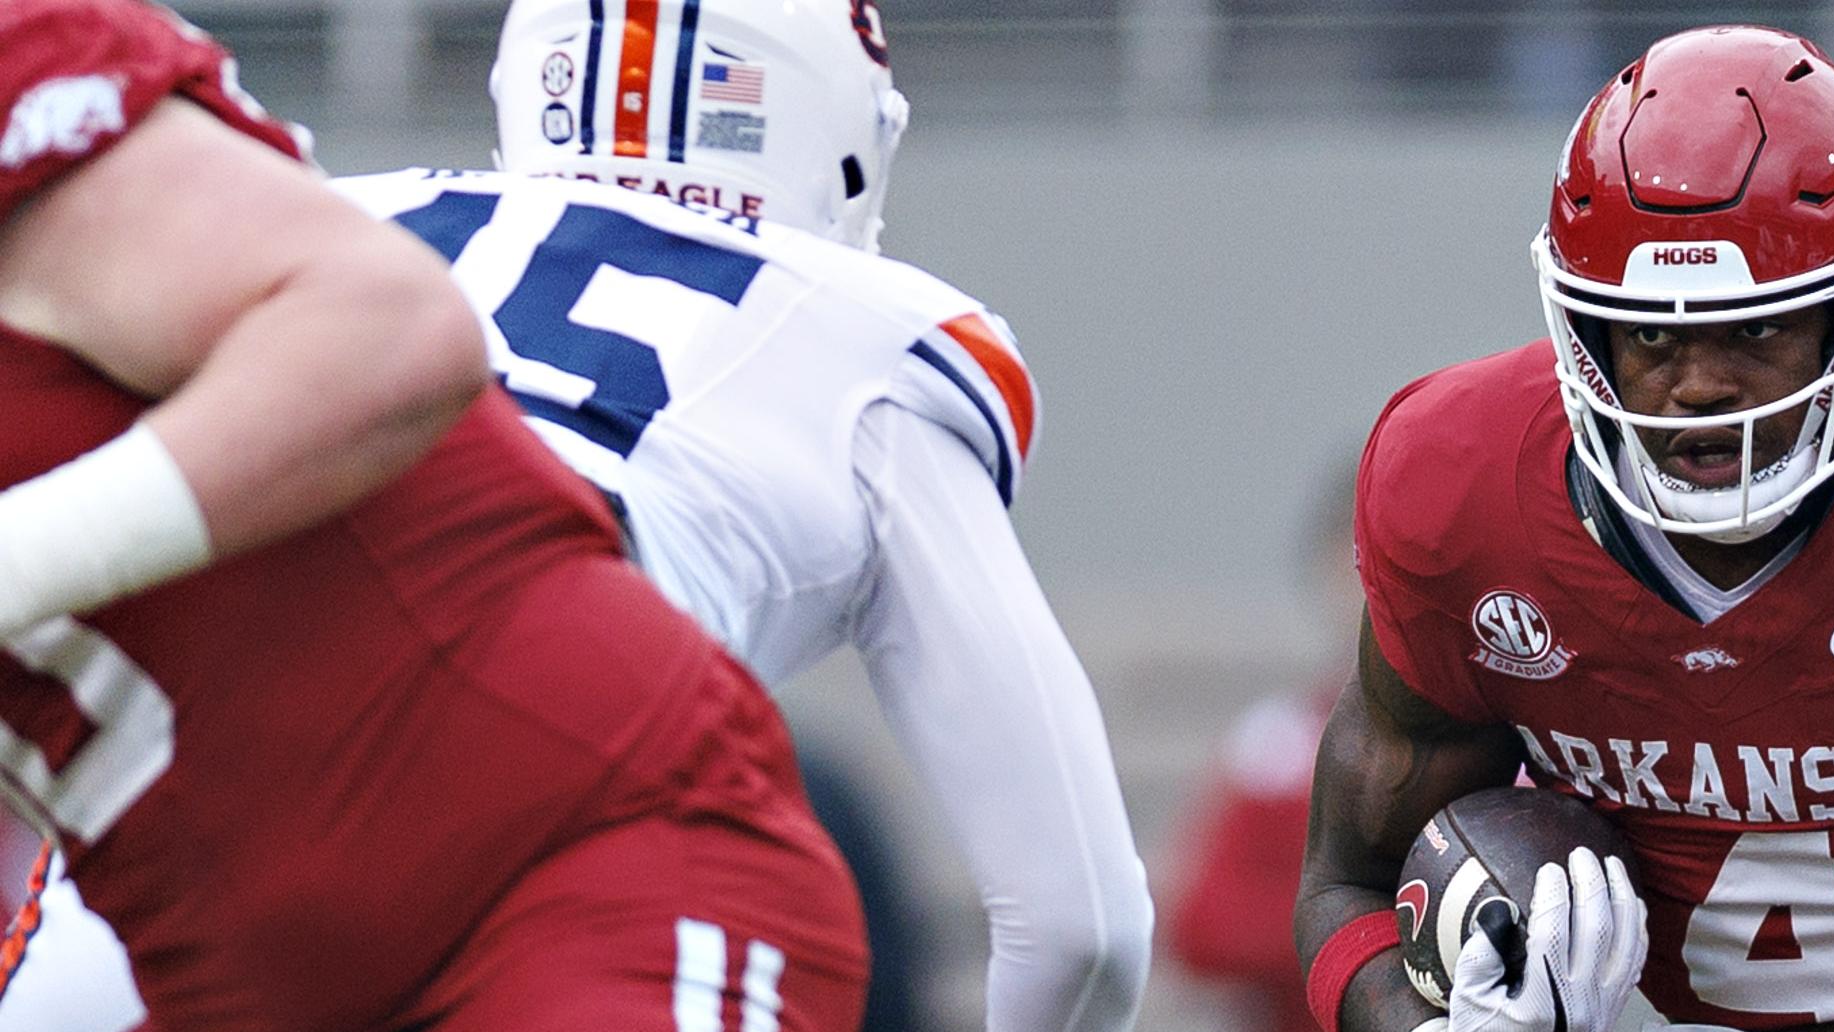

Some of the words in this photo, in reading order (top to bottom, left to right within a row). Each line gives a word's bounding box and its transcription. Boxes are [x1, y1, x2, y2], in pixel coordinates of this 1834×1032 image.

[1653, 246, 1718, 266] HOGS
[1479, 595, 1546, 656] SEC
[1494, 658, 1561, 677] GRADUATE
